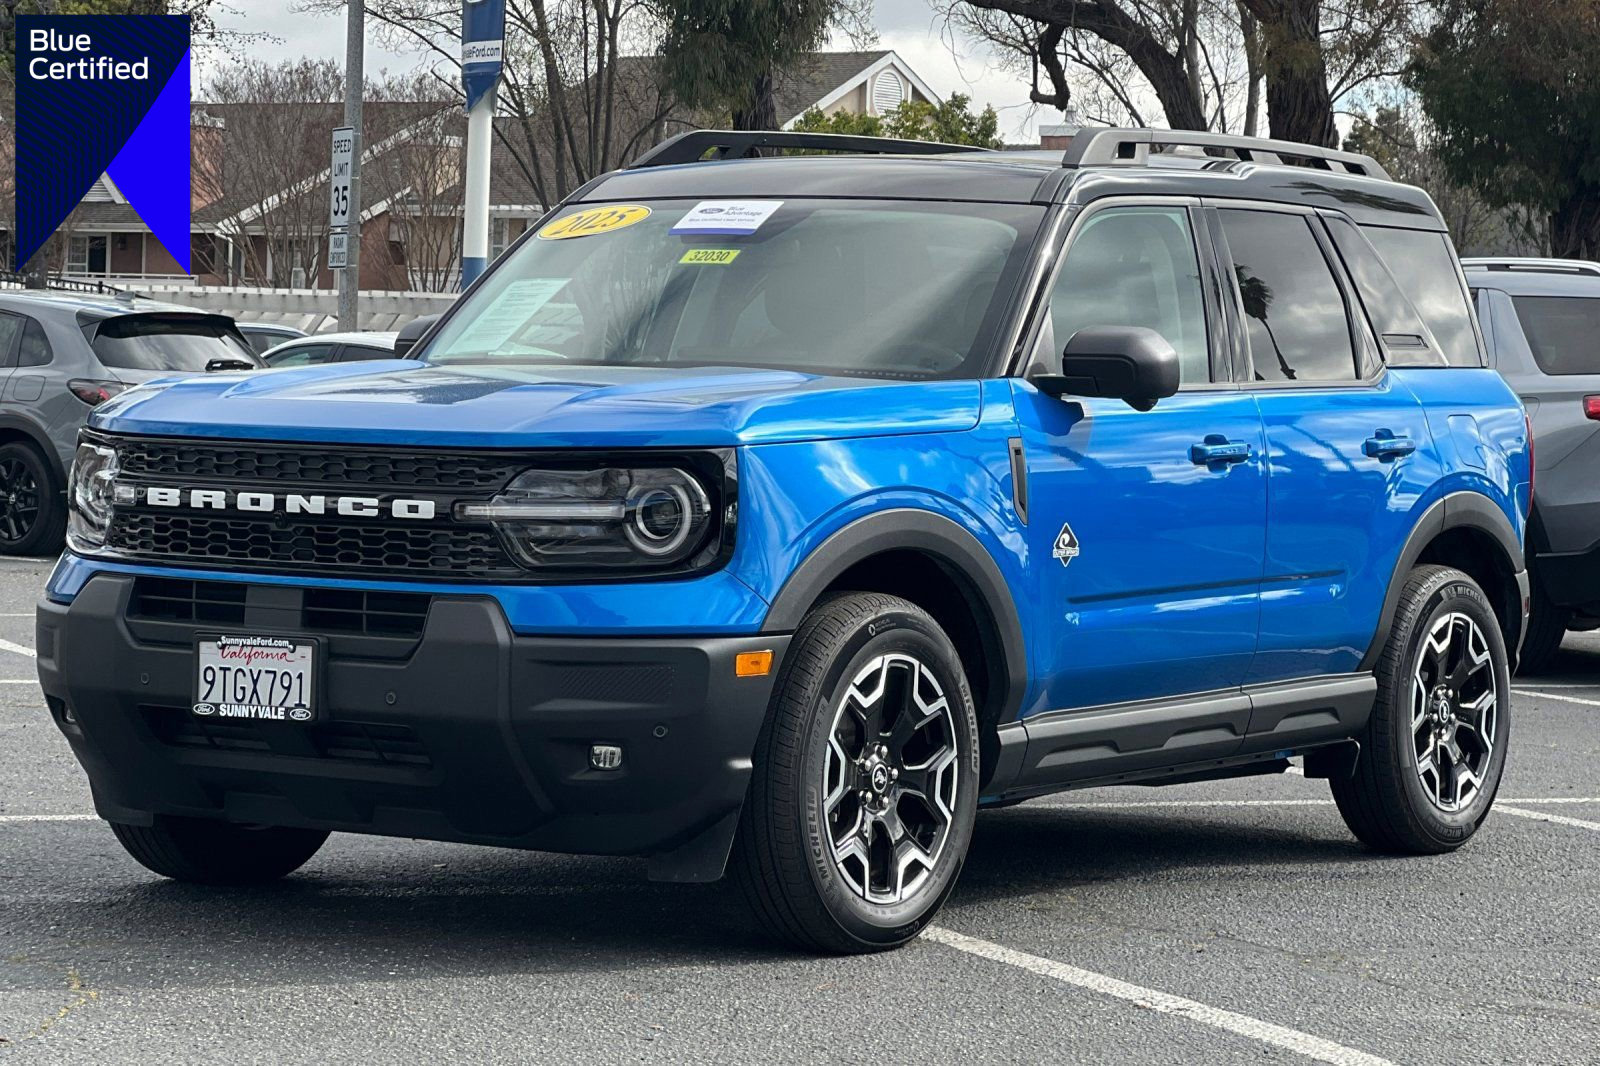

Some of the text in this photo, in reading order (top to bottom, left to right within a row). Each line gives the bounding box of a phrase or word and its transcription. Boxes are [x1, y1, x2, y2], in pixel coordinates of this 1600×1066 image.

[333, 139, 351, 153] SPEED
[334, 162, 349, 177] LIMIT
[333, 185, 348, 216] 35
[549, 209, 639, 236] 2025
[689, 251, 730, 262] 32030
[147, 487, 435, 519] BRONCO
[221, 636, 289, 647] SunnyvaleFord.com
[220, 645, 295, 665] California
[202, 665, 307, 708] 9TGX791
[196, 704, 308, 719] Ford SUNNYVALE Ford
[960, 683, 979, 770] MICHELIN
[807, 786, 830, 881] MICHELIN
